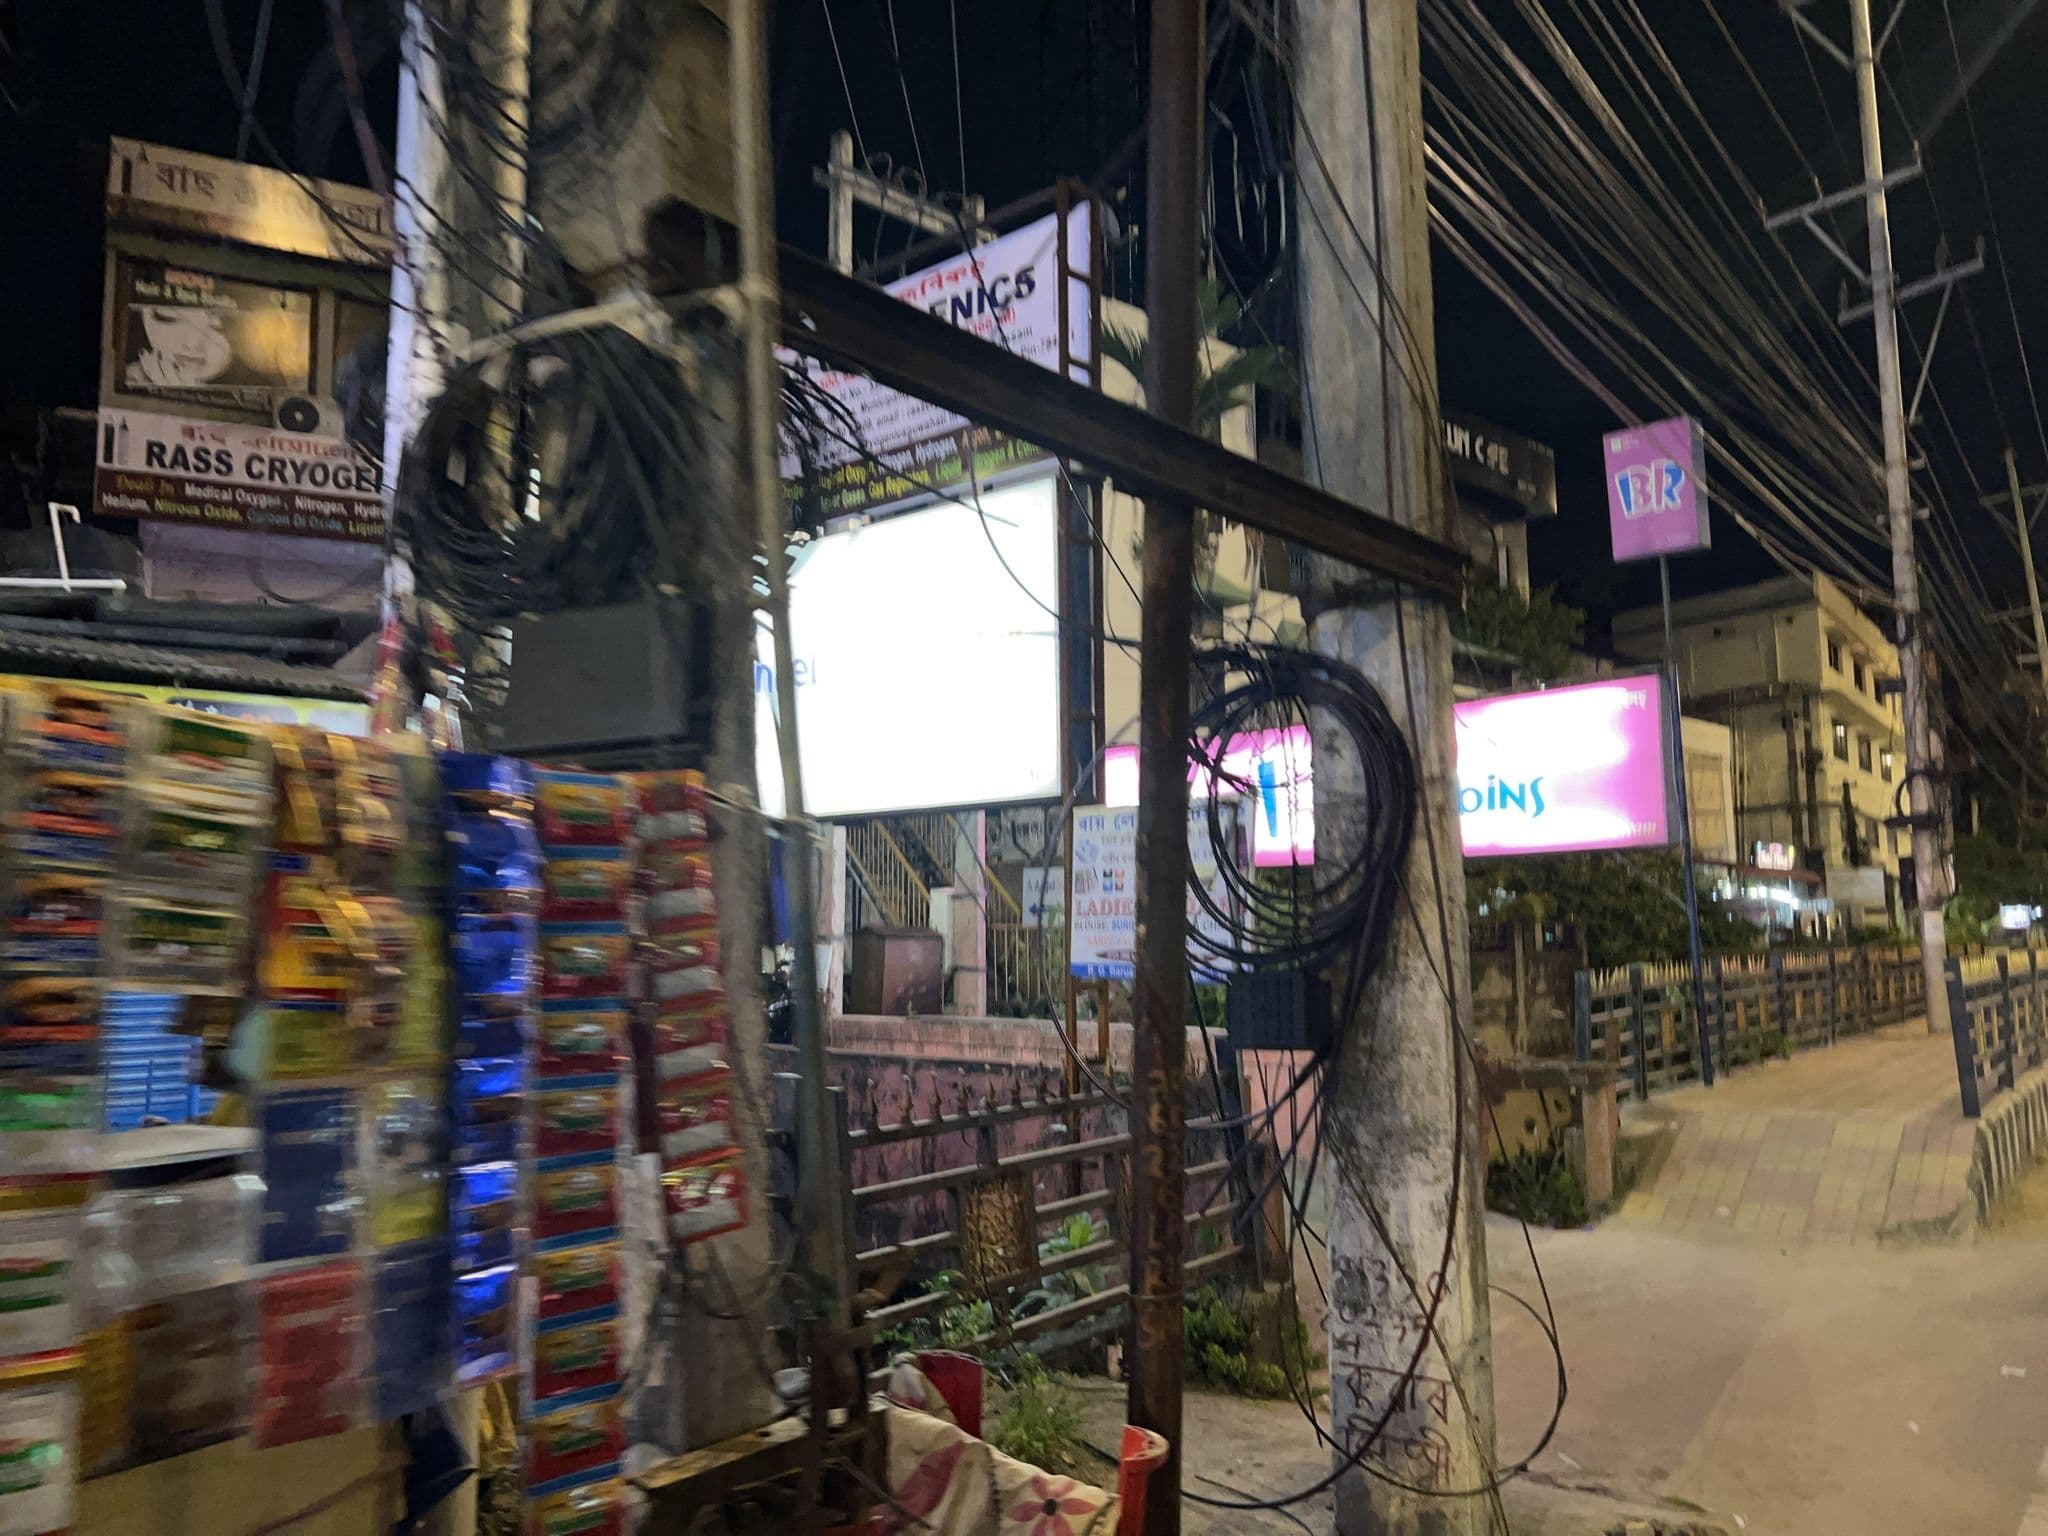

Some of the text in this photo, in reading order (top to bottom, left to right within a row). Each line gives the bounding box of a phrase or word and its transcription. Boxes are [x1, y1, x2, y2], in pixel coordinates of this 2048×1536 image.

[145, 439, 234, 477] RASS
[184, 482, 233, 502] Medical
[1614, 459, 1686, 520] BR
